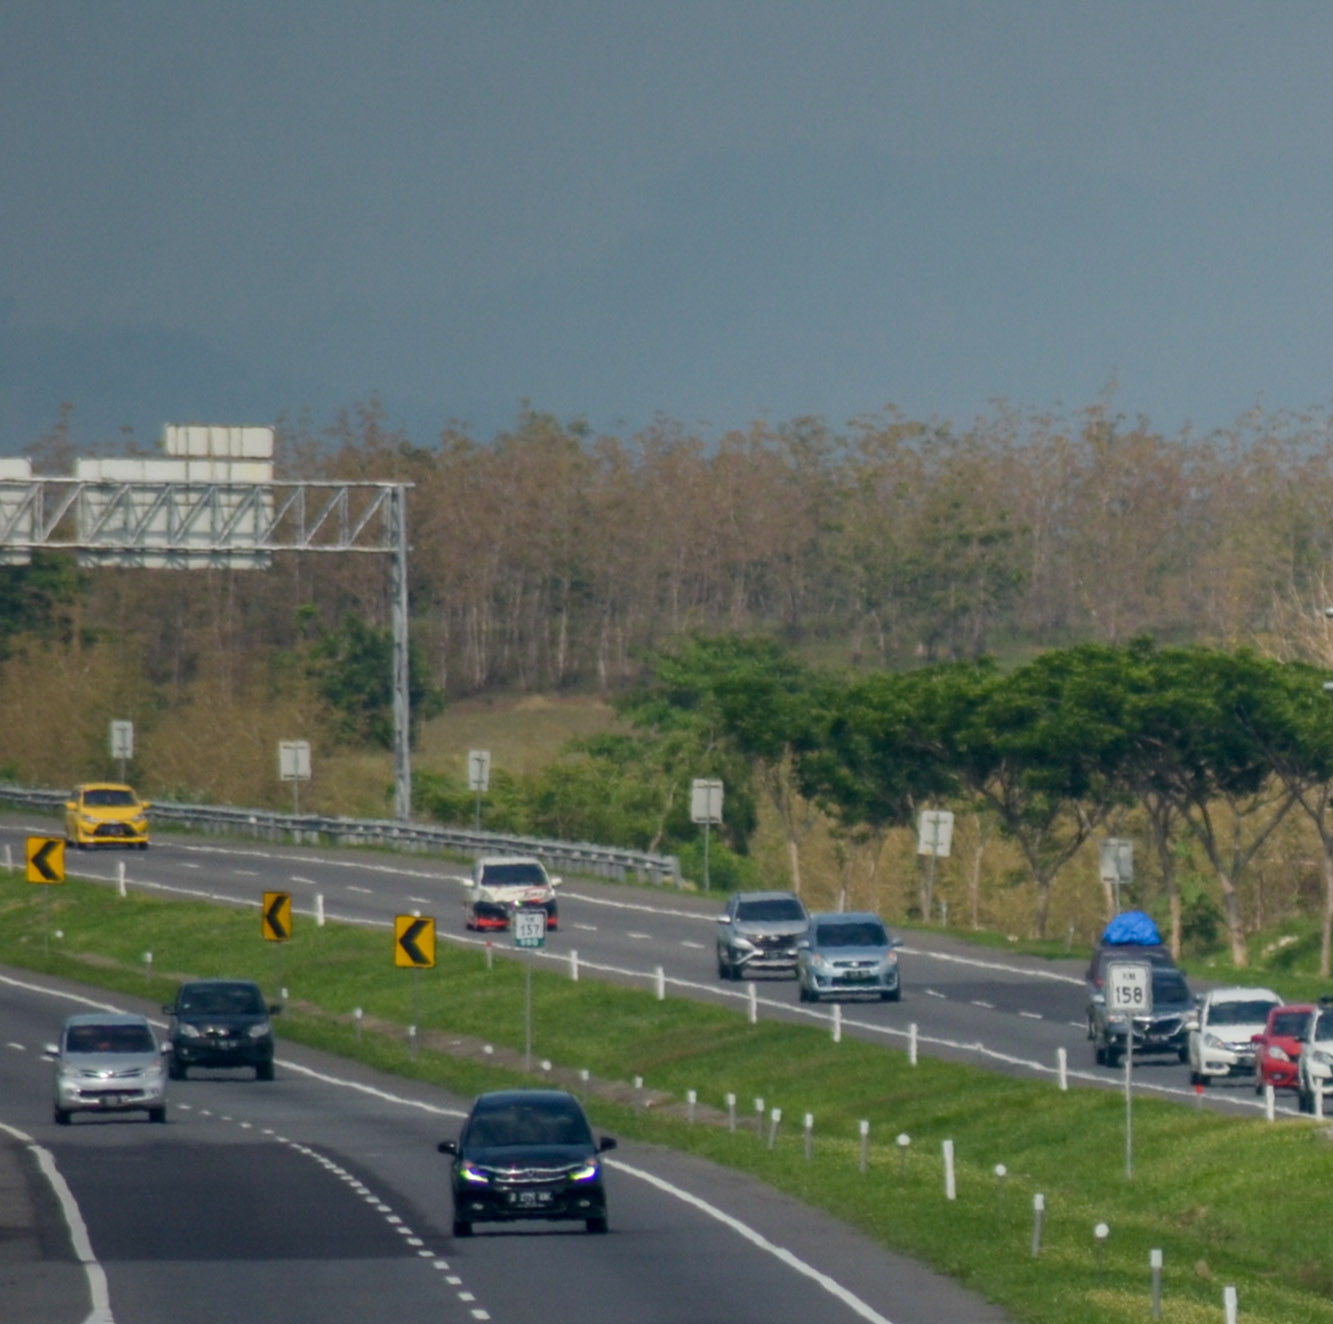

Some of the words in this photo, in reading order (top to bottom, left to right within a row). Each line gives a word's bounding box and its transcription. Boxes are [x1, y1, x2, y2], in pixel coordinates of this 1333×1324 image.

[521, 924, 540, 936] 157
[1122, 972, 1137, 981] KM
[1115, 986, 1143, 1004] 158
